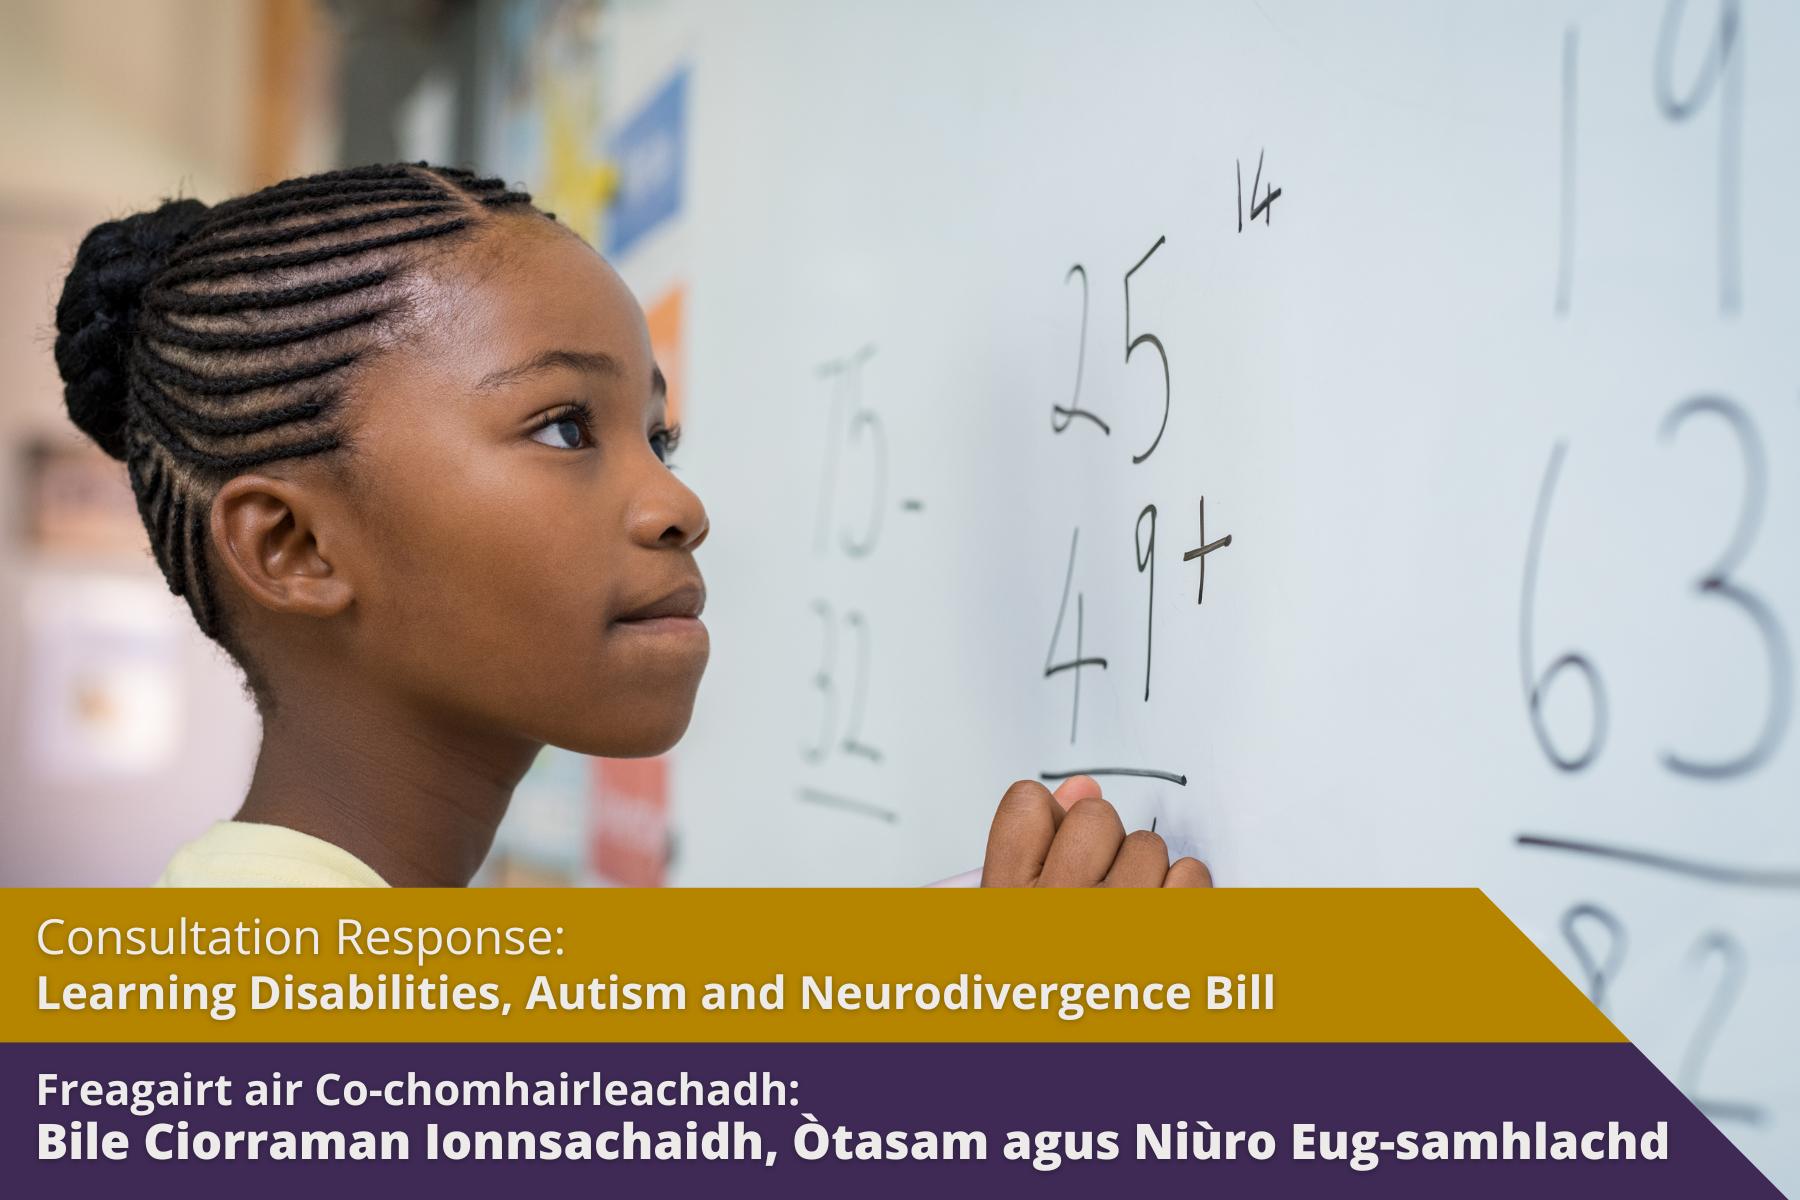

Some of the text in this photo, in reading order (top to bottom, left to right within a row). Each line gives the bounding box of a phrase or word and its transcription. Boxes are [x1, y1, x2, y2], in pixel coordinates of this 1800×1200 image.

[1235, 147, 1282, 233] 14
[1051, 233, 1170, 465] 25
[1518, 393, 1793, 782] 63
